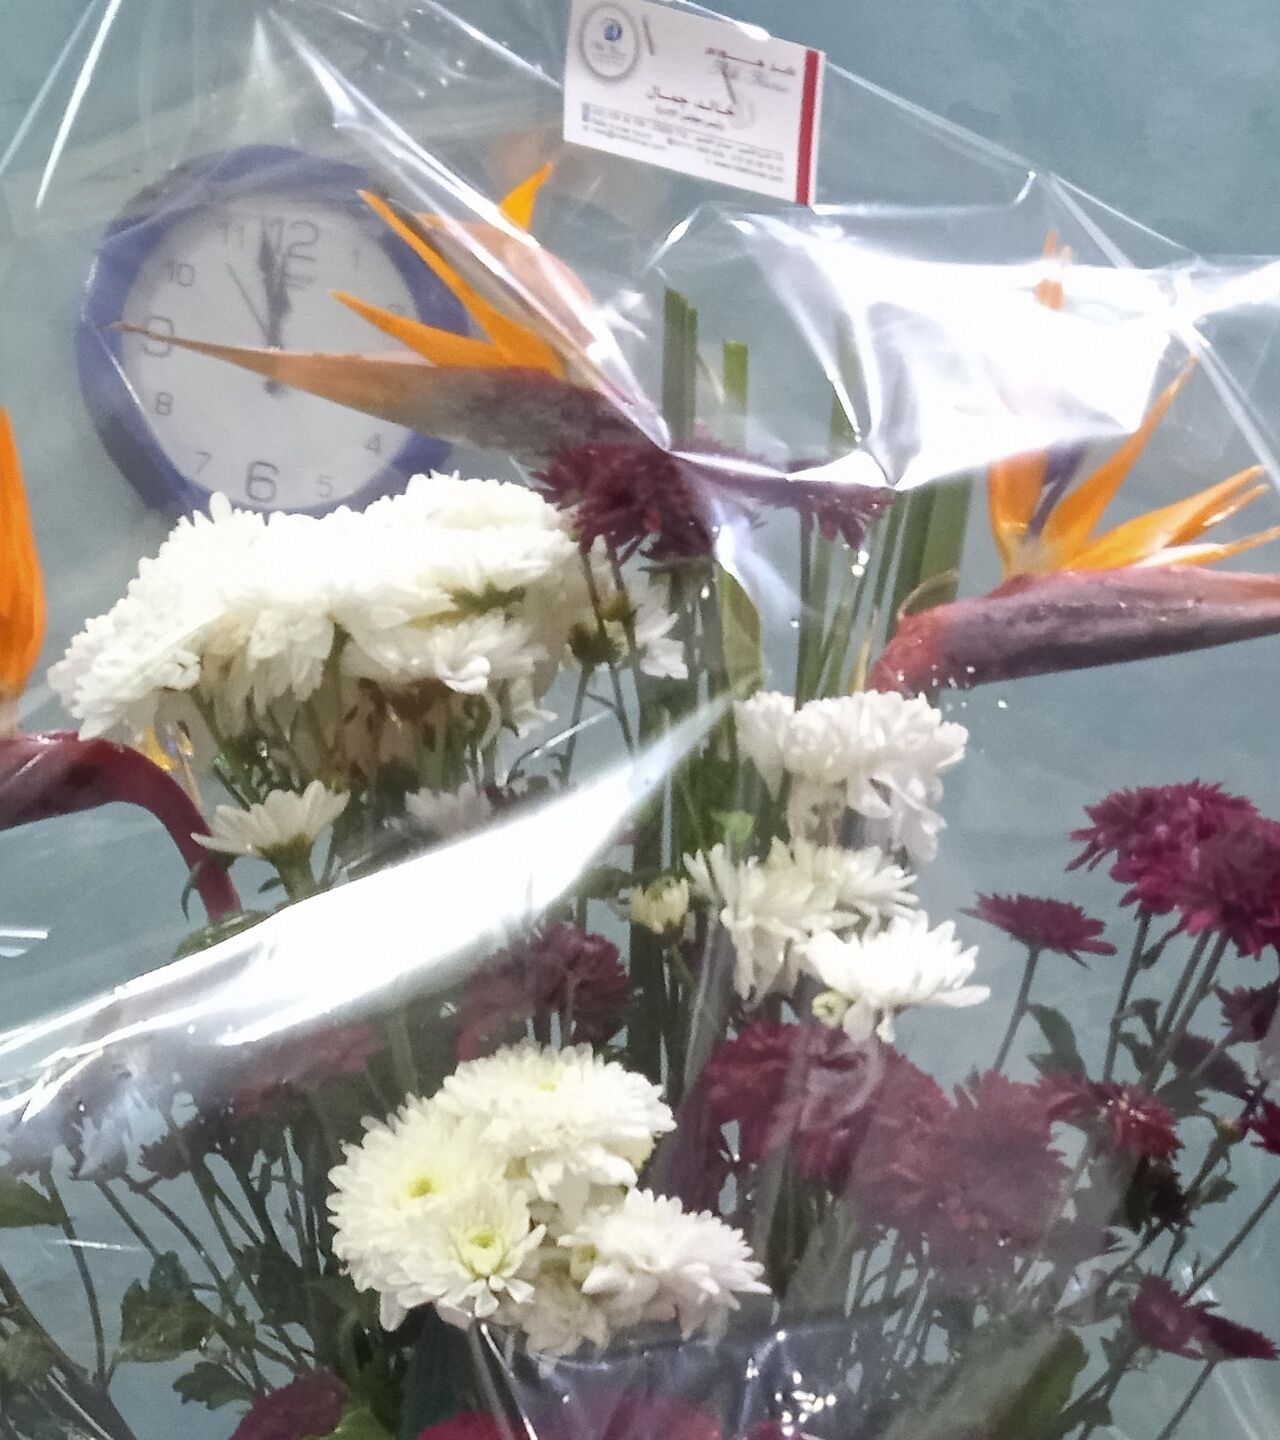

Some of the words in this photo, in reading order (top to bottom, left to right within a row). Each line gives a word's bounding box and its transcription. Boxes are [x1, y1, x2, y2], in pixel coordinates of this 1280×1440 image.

[269, 218, 320, 262] 12
[165, 262, 196, 288] 10
[155, 392, 174, 417] 8
[365, 433, 383, 455] 4
[194, 452, 212, 473] 7
[245, 460, 280, 504] 6
[316, 474, 335, 499] 5
